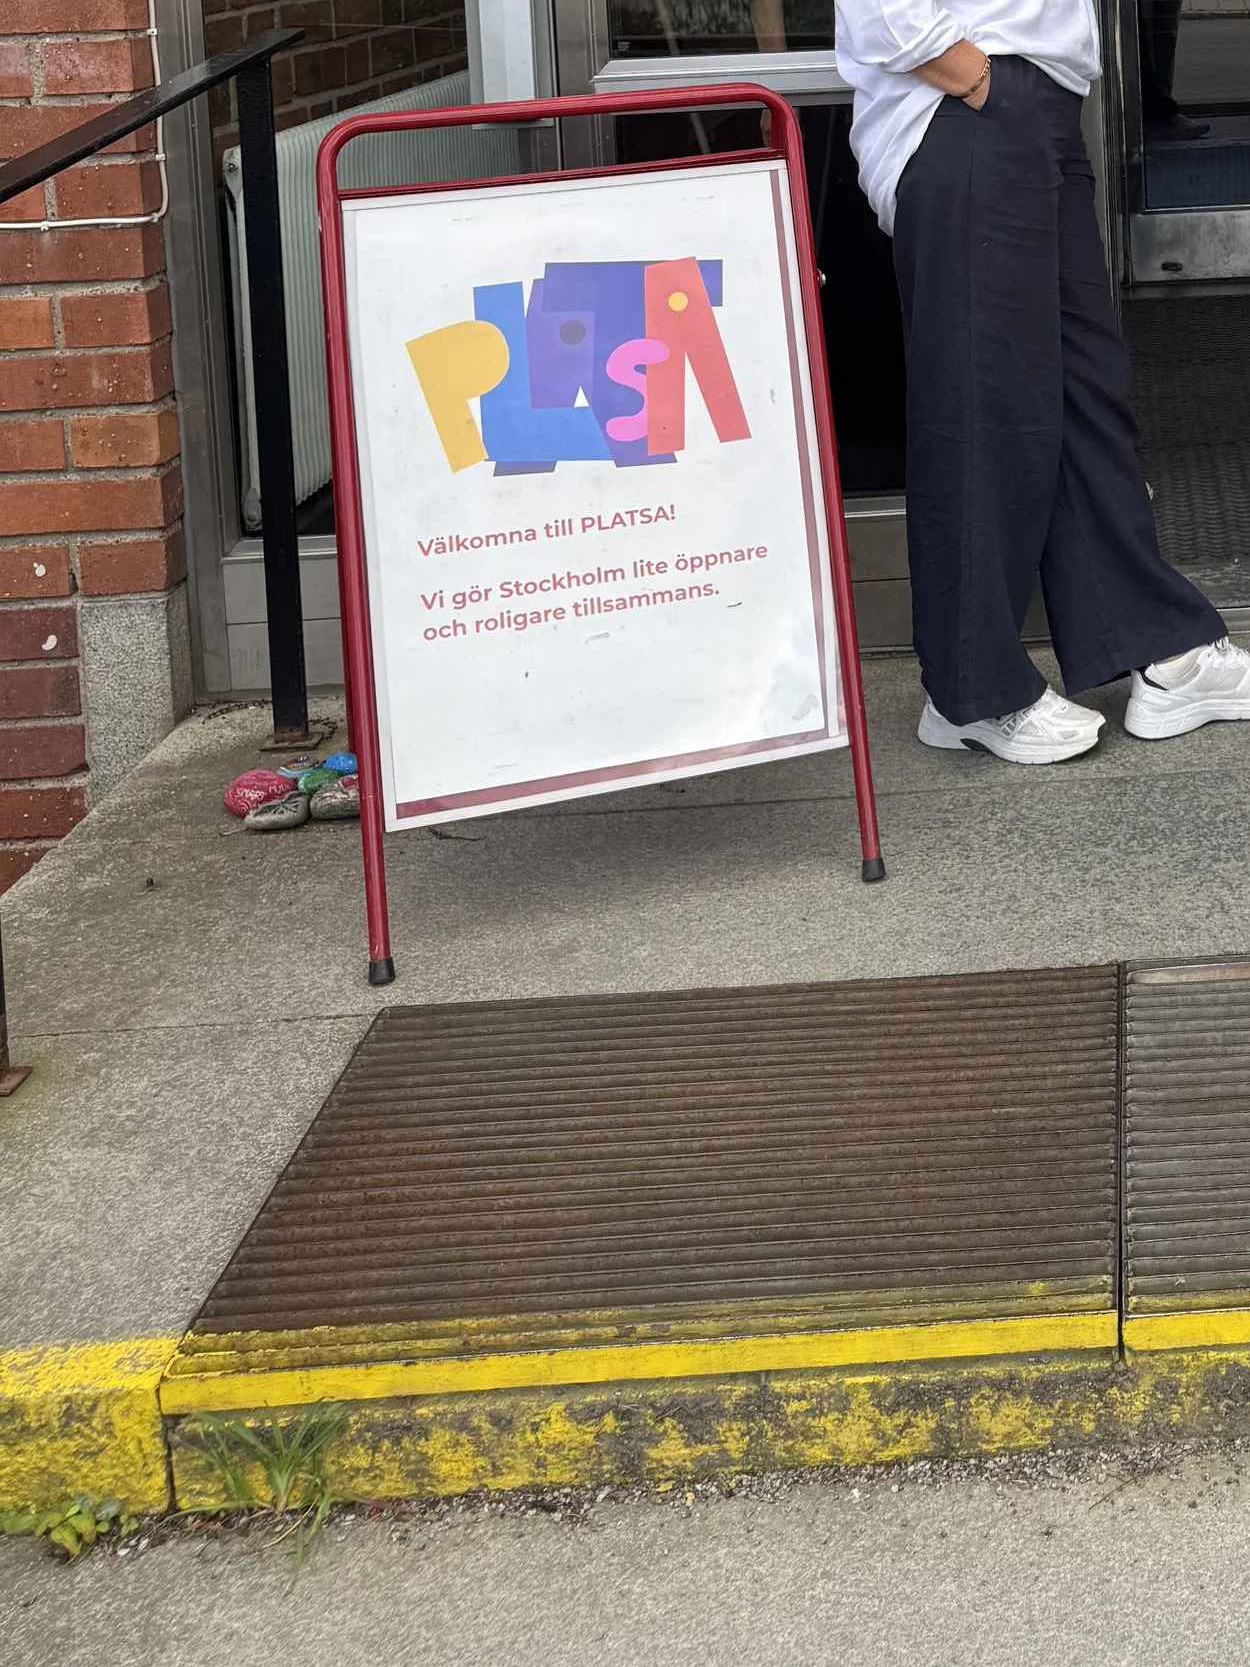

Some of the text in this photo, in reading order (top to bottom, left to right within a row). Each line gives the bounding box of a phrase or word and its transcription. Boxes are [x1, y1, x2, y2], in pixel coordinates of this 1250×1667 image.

[416, 504, 676, 557] Välkomna till PLATSA!
[420, 545, 769, 611] Vi gör Stockholm lite öppnare
[422, 583, 720, 641] och roligare tillsammans.
